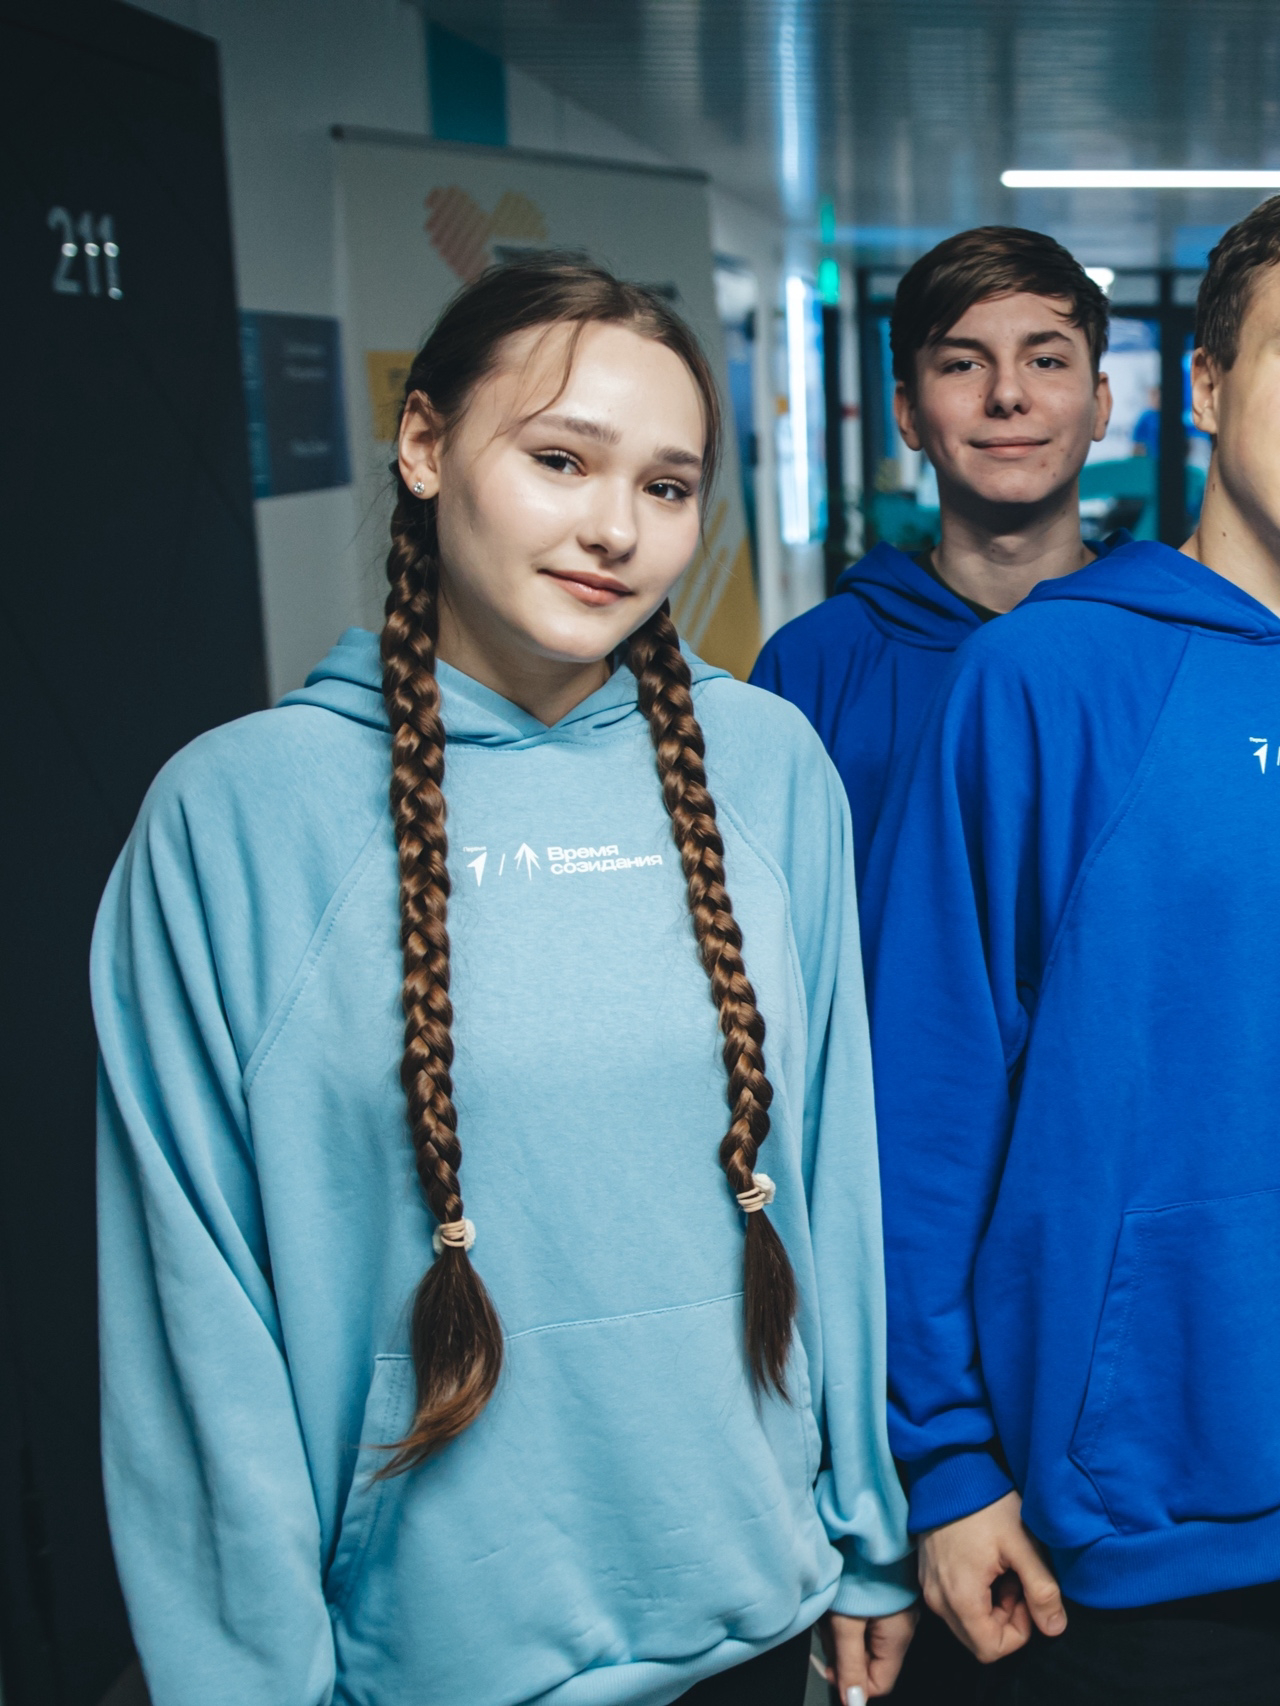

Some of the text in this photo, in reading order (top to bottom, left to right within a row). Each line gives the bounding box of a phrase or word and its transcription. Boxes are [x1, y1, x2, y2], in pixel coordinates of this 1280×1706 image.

[48, 206, 123, 300] 211
[547, 845, 619, 862] Время
[550, 854, 663, 875] созидания
